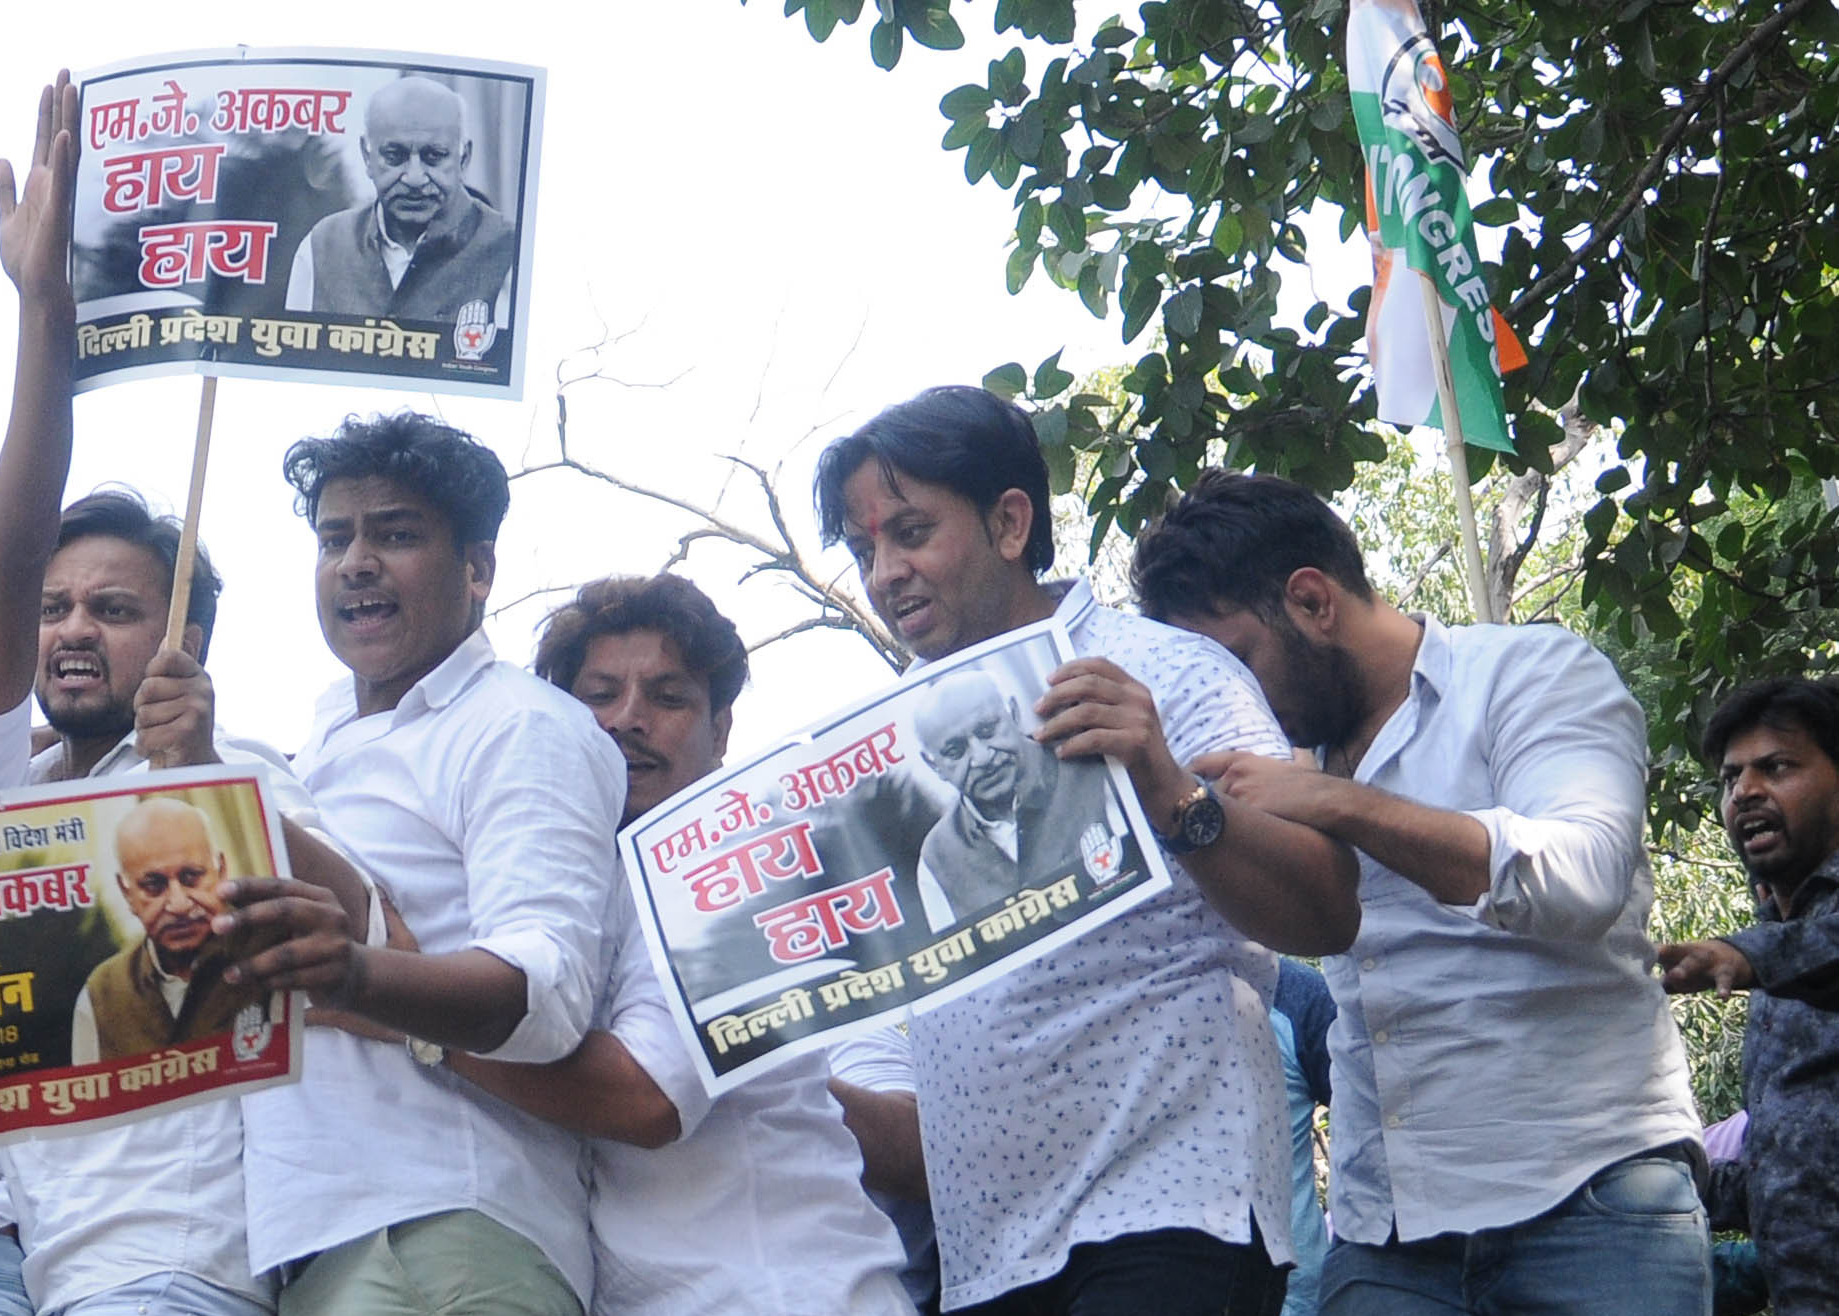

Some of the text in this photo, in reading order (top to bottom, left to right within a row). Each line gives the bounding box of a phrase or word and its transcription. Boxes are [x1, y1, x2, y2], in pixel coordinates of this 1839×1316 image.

[91, 80, 352, 149] एम.जे. अकबर
[103, 146, 225, 212] हाय
[141, 224, 274, 285] हाय
[77, 310, 440, 361] दिल्ली प्रदेश युवा कांग्रेस
[650, 722, 905, 874] एम.जे. अकबर
[5, 823, 49, 850] विदेश
[54, 818, 86, 843] मंत्री
[682, 822, 820, 912] हाय
[756, 870, 902, 961] हाय
[707, 988, 813, 1054] दिल्ली
[818, 960, 905, 1012] प्रदेश
[908, 928, 977, 983] युवा
[976, 874, 1080, 944] कांग्रेस
[40, 1072, 112, 1114] युवा
[119, 1045, 220, 1092] कांग्रेस
